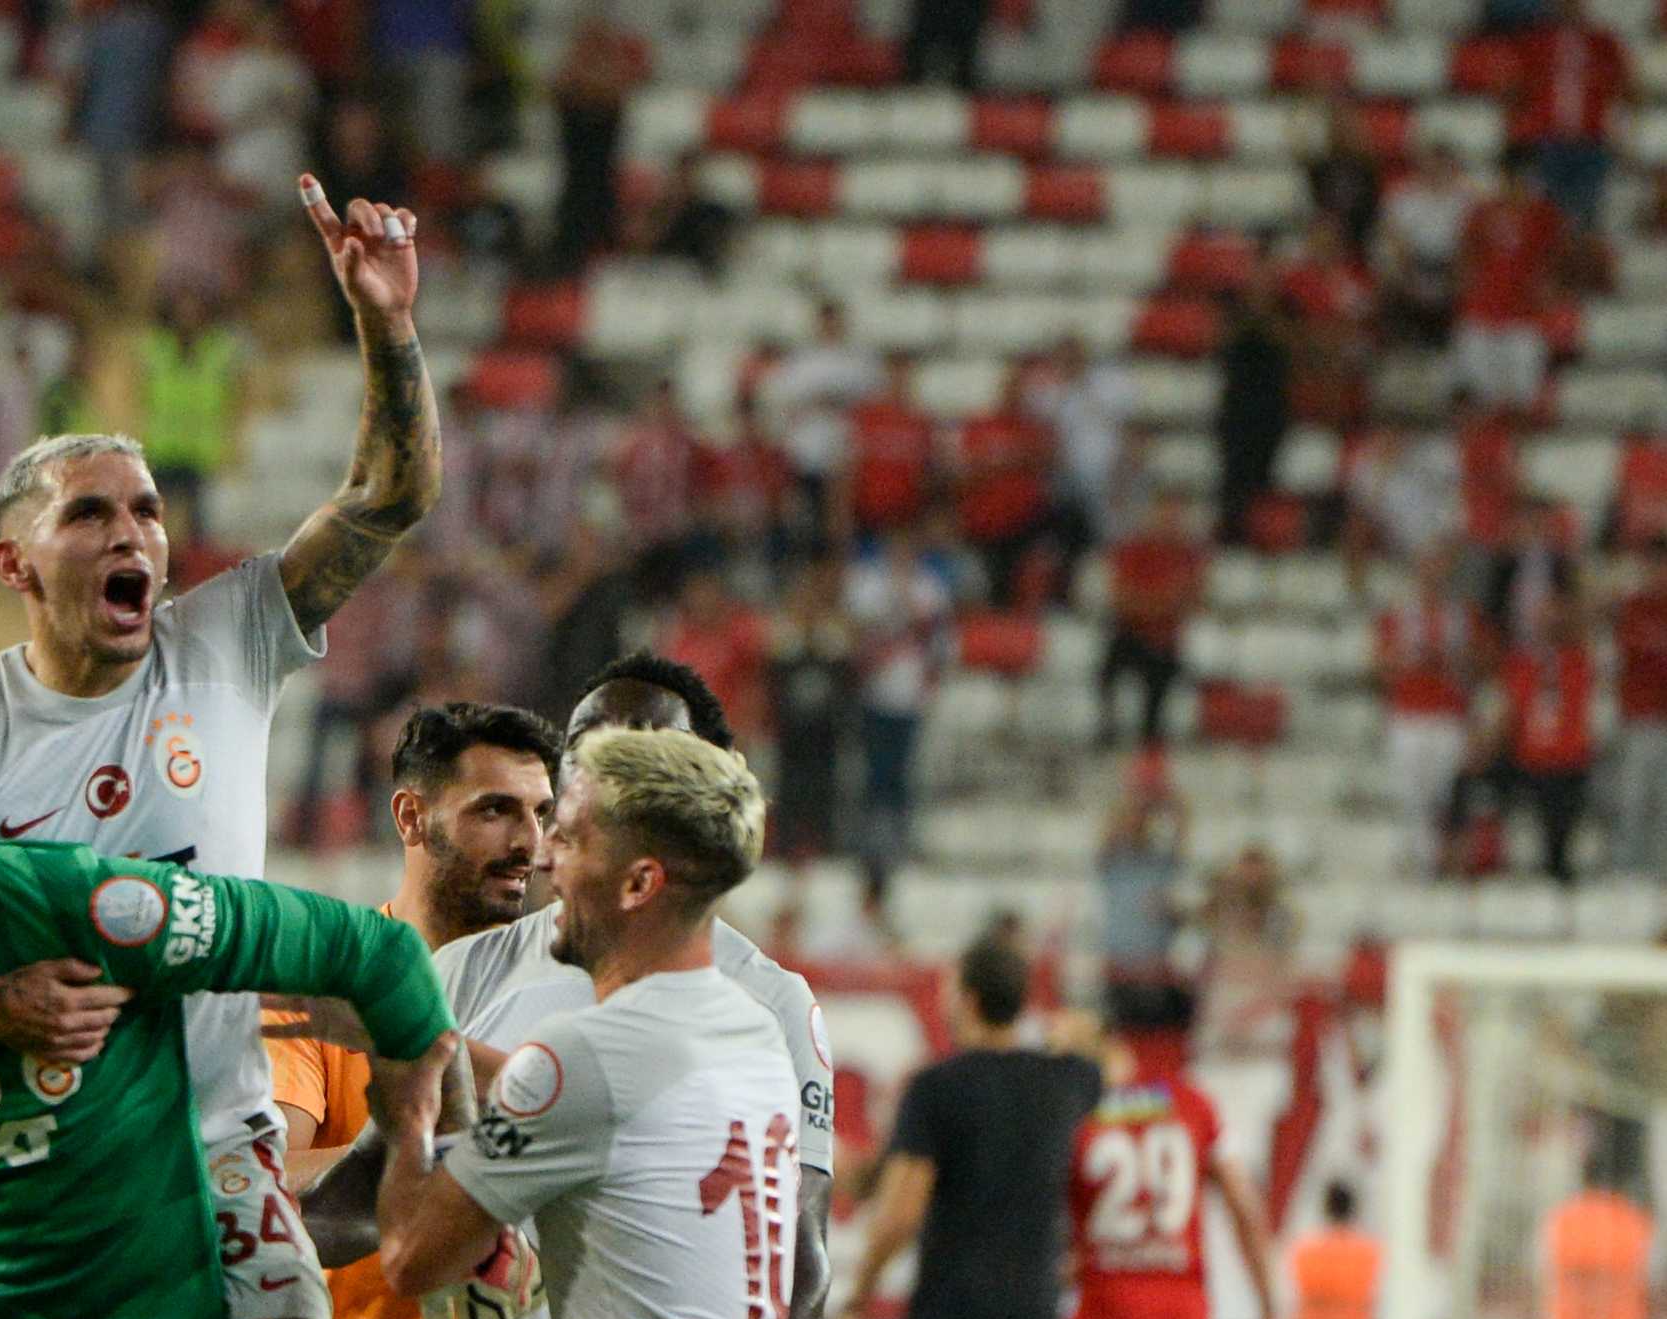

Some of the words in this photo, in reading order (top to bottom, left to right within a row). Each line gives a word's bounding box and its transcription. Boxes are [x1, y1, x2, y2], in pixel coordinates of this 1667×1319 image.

[163, 872, 203, 966] GKN
[1087, 1125, 1196, 1239] 29
[216, 1194, 302, 1266] 34
